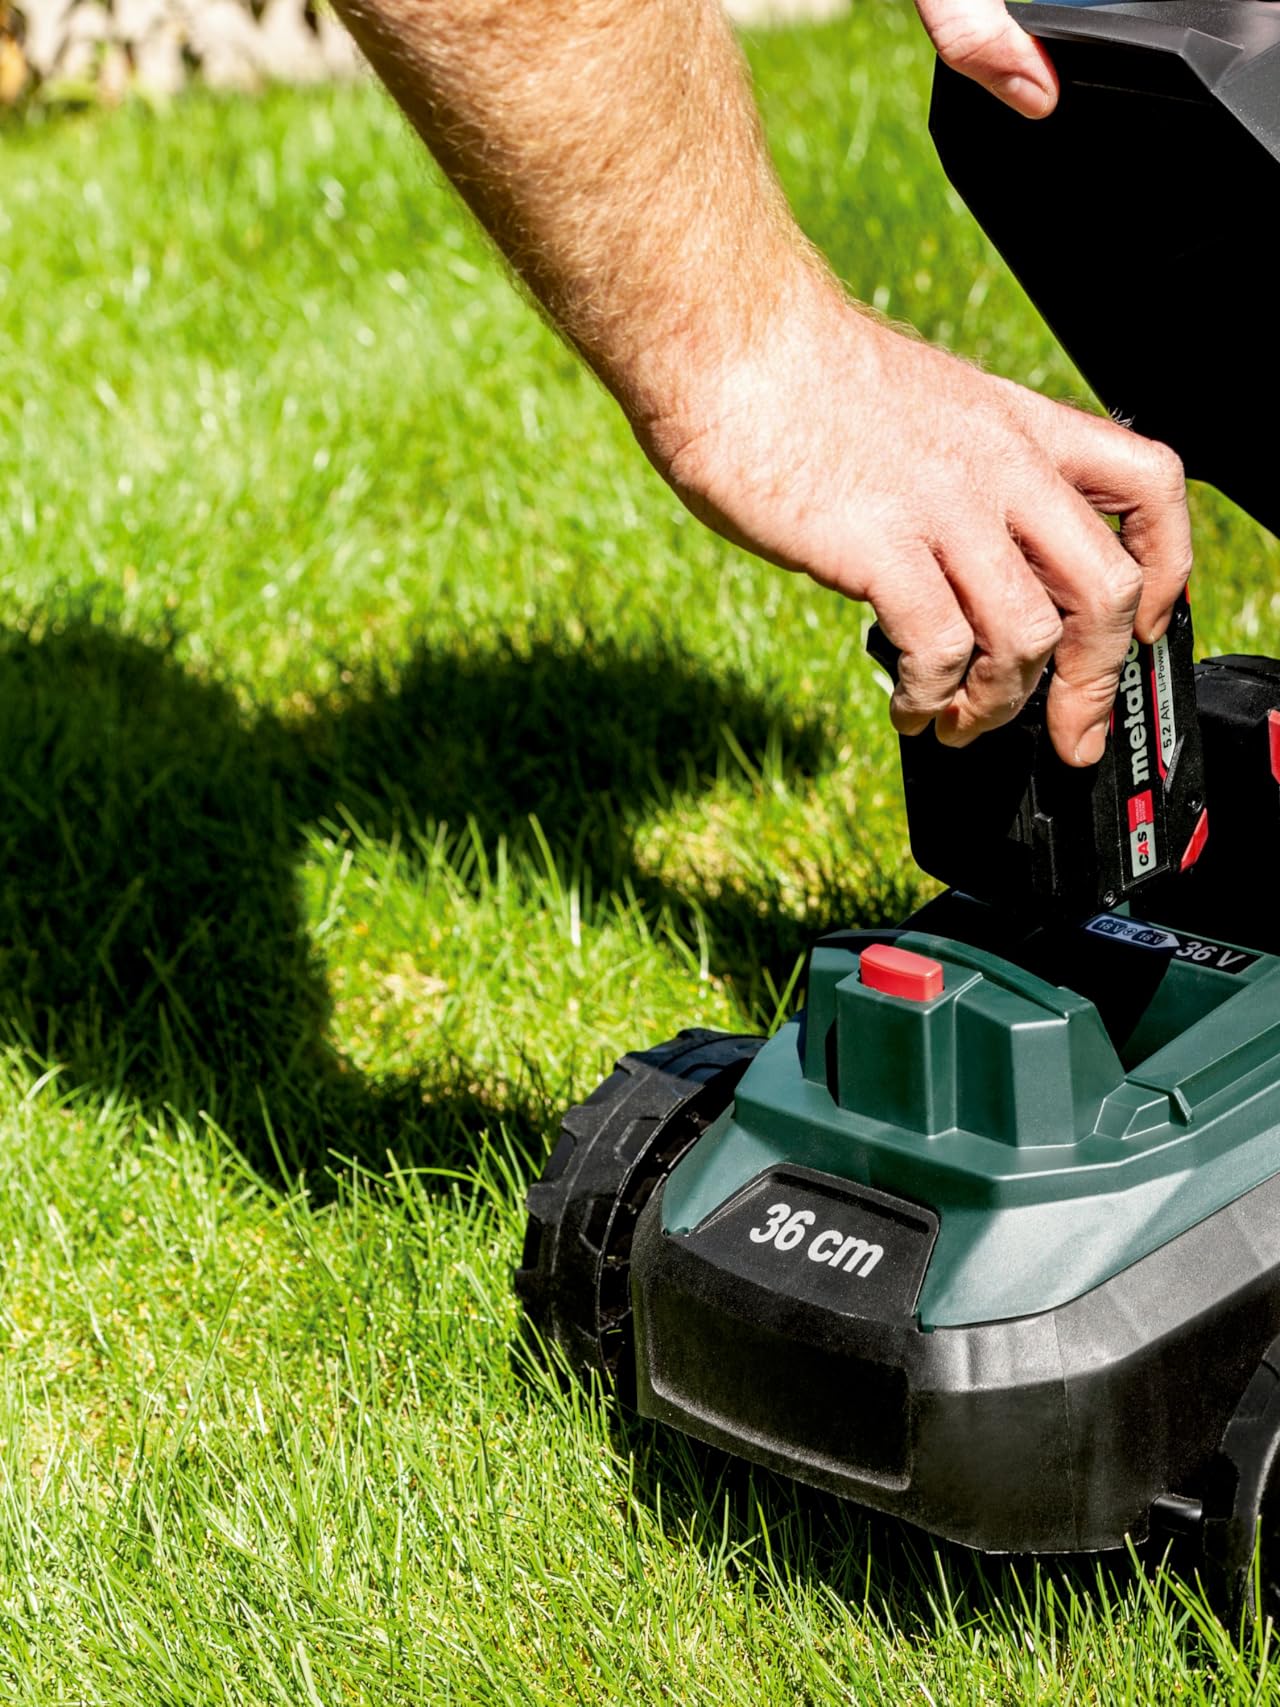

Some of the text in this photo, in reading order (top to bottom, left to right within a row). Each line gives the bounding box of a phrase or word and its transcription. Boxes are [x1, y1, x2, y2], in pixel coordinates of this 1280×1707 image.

[1120, 638, 1150, 786] metabo
[1157, 645, 1172, 749] 5.2 Ah Li-Power
[1137, 831, 1149, 867] CAS
[1099, 921, 1113, 930] 18
[1138, 932, 1151, 942] 18
[1175, 941, 1246, 967] 36 V
[749, 1203, 884, 1278] 36 cm
